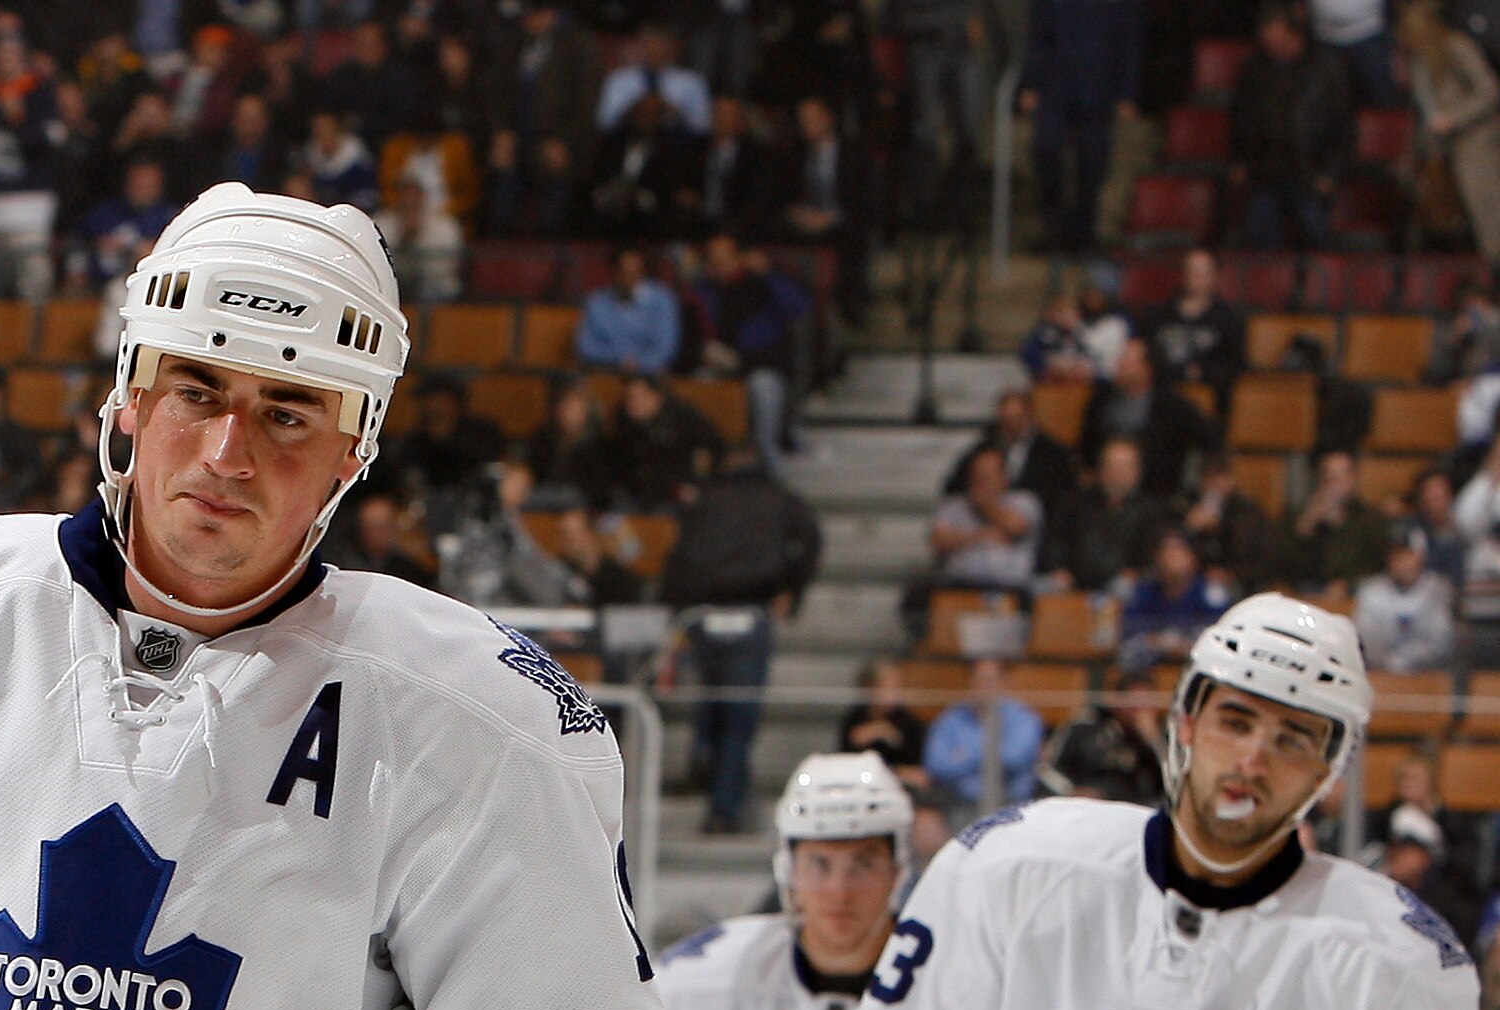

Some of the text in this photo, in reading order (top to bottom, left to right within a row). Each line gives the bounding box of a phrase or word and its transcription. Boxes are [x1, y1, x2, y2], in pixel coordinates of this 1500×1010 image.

[218, 289, 308, 318] CCM
[143, 643, 172, 660] NHL
[265, 681, 343, 820] A
[870, 919, 934, 1005] 3
